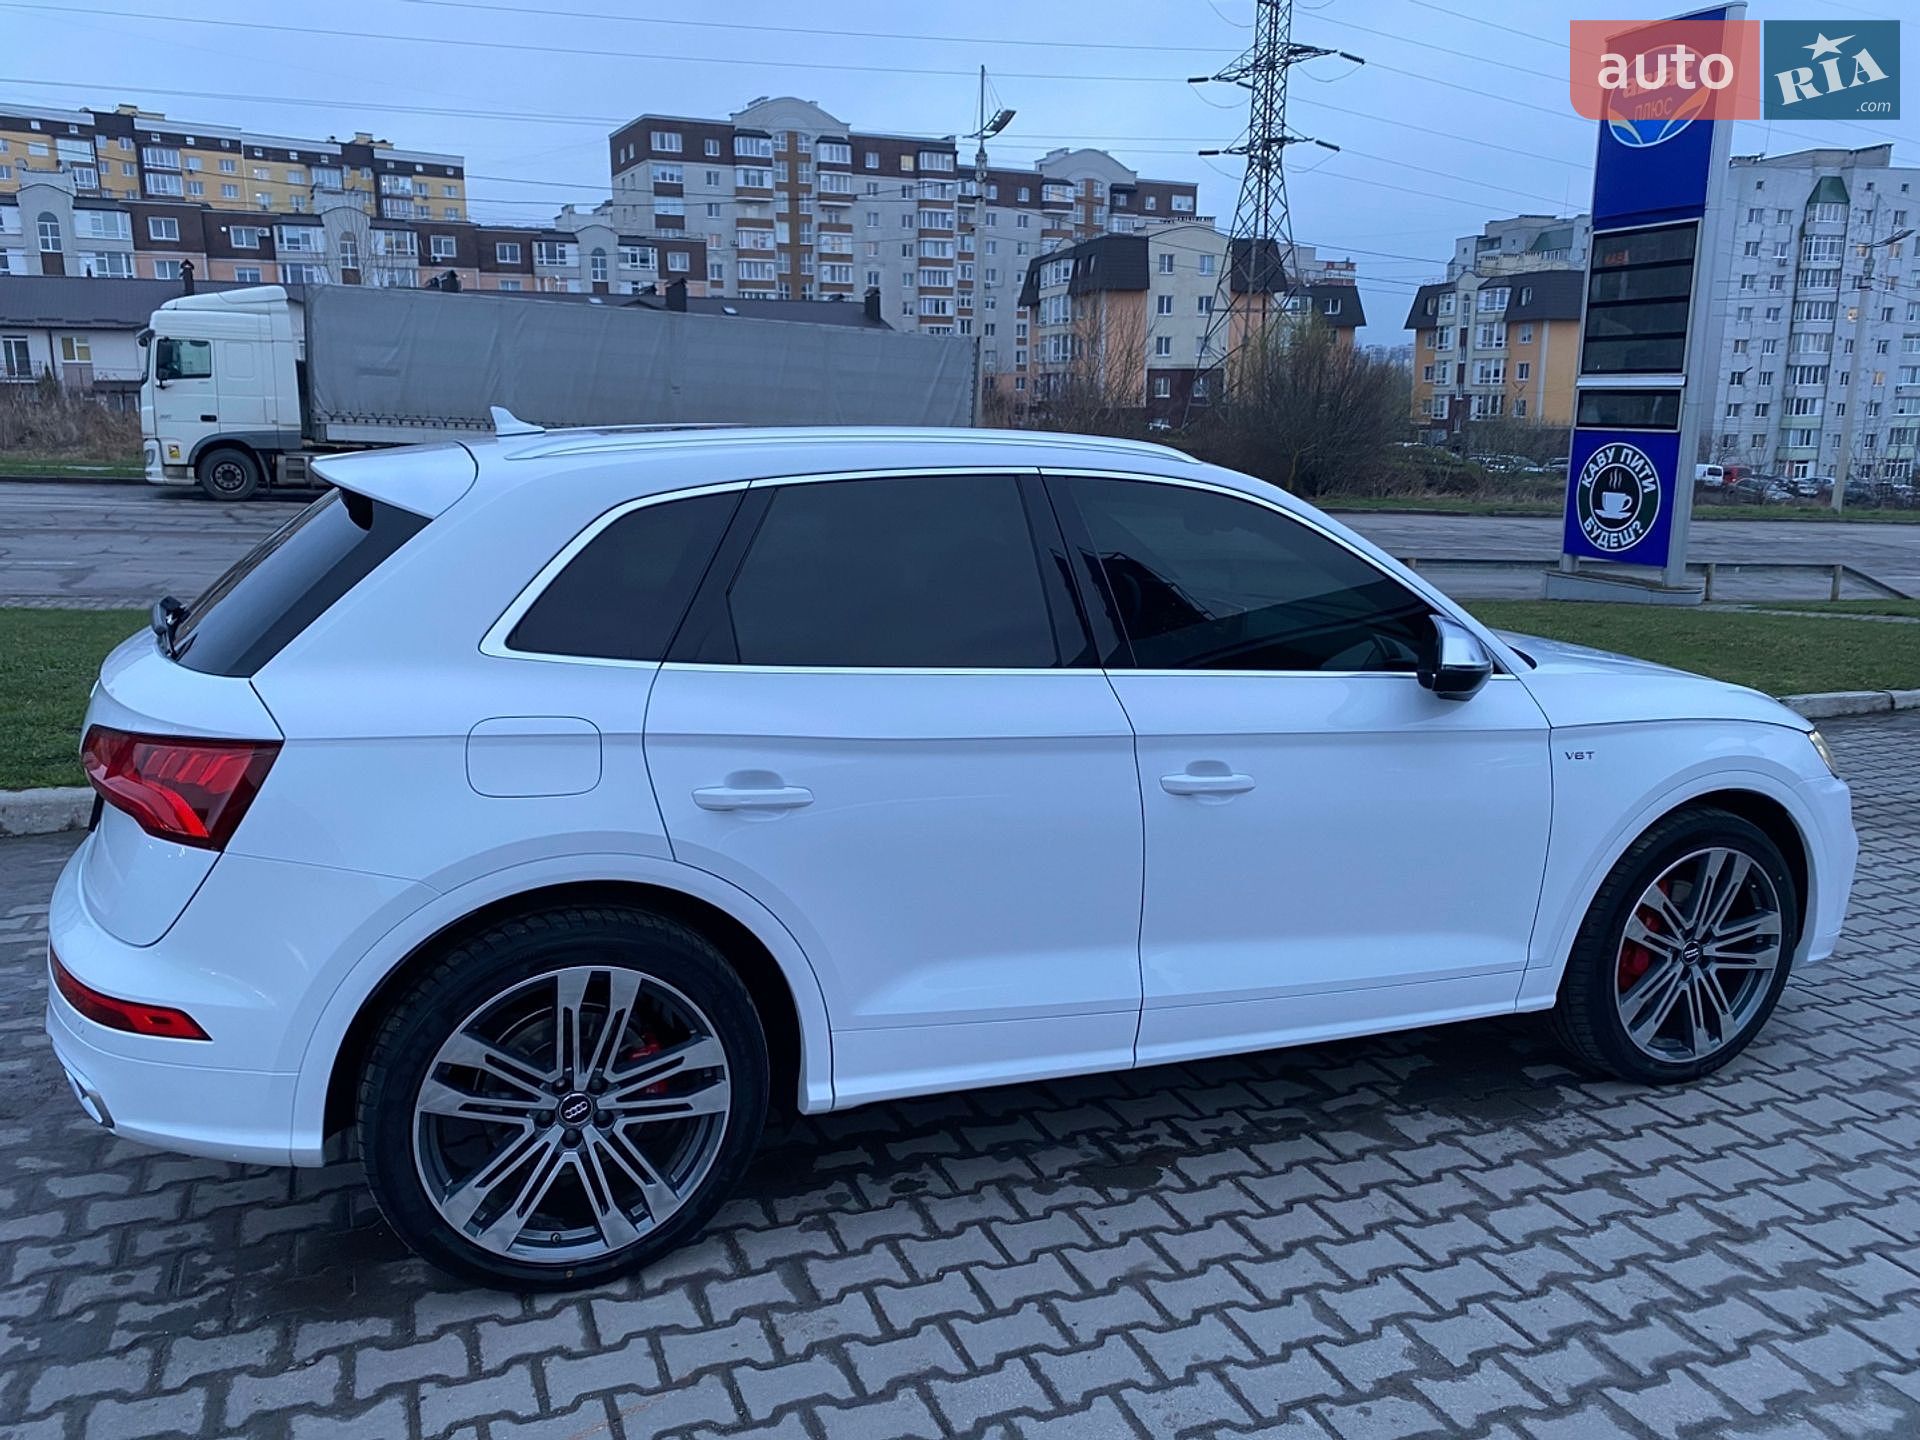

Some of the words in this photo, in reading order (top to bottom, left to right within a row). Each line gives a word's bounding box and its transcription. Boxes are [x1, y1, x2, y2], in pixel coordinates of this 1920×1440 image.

[1581, 447, 1616, 488] КАВУ
[1620, 448, 1657, 493] ПИТИ
[1583, 516, 1644, 549] БУДЕШ?
[1565, 751, 1595, 760] V6T
